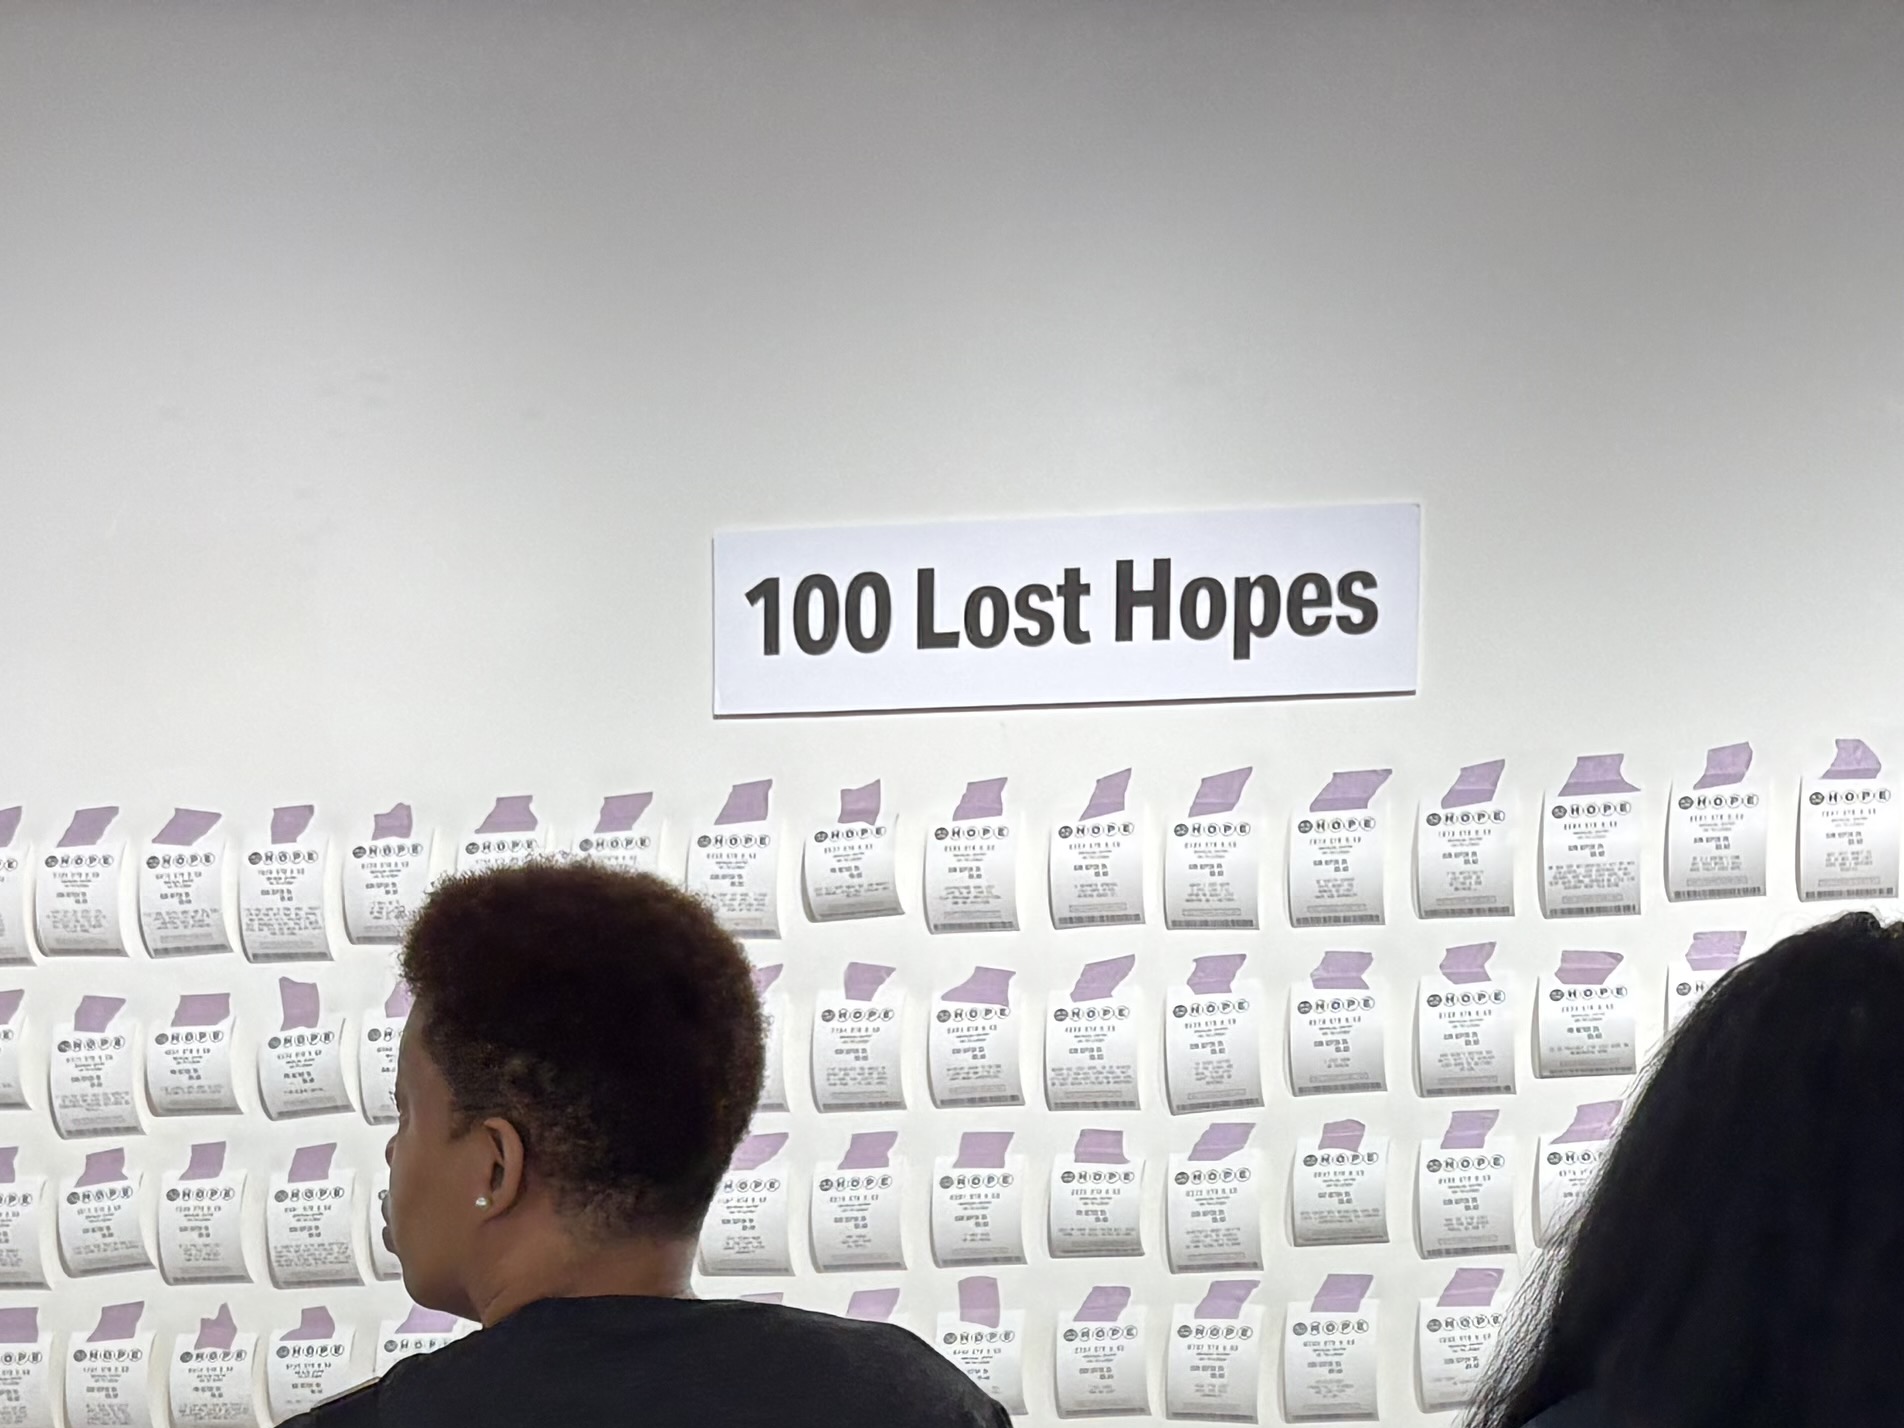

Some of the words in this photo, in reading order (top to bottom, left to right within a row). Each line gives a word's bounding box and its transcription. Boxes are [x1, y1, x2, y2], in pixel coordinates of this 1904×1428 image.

[745, 571, 891, 655] 100
[916, 567, 1092, 650] Lost
[1115, 558, 1378, 660] Hopes
[1696, 796, 1757, 809] HOPE
[1828, 789, 1889, 805] HOPE
[1569, 802, 1630, 818] HOPE
[1444, 810, 1505, 826] HOPE
[1075, 823, 1133, 838] HOPE
[1191, 823, 1249, 837] HOPE
[1315, 818, 1373, 833] HOPE
[830, 826, 884, 841] HOPE
[951, 827, 1007, 840] HOPE
[595, 837, 649, 851] HOPE
[715, 835, 770, 847] HOPE
[266, 850, 317, 863] HOPE
[370, 843, 422, 857] HOPE
[62, 855, 112, 867] HOPE
[163, 853, 214, 866] HOPE
[1445, 991, 1503, 1006] HOPE
[1567, 986, 1625, 1001] HOPE
[1190, 1000, 1248, 1017] HOPE
[1315, 998, 1373, 1013] HOPE
[839, 1009, 894, 1021] HOPE
[953, 1007, 1009, 1021] HOPE
[1071, 1008, 1127, 1021] HOPE
[74, 1036, 125, 1051] HOPE
[170, 1031, 221, 1044] HOPE
[284, 1032, 333, 1046] HOPE
[1320, 1152, 1376, 1166] HOPE
[1445, 1156, 1503, 1171] HOPE
[838, 1176, 890, 1190] HOPE
[956, 1174, 1012, 1188] HOPE
[1077, 1171, 1133, 1184] HOPE
[1192, 1169, 1250, 1184] HOPE
[83, 1188, 132, 1202] HOPE
[183, 1188, 233, 1200] HOPE
[292, 1187, 344, 1201] HOPE
[1080, 1327, 1136, 1341] HOPE
[1195, 1326, 1251, 1340] HOPE
[1312, 1320, 1369, 1334] HOPE
[959, 1332, 1013, 1344] HOPE
[90, 1349, 140, 1361] HOPE
[195, 1352, 244, 1363] HOPE
[292, 1346, 343, 1358] HOPE
